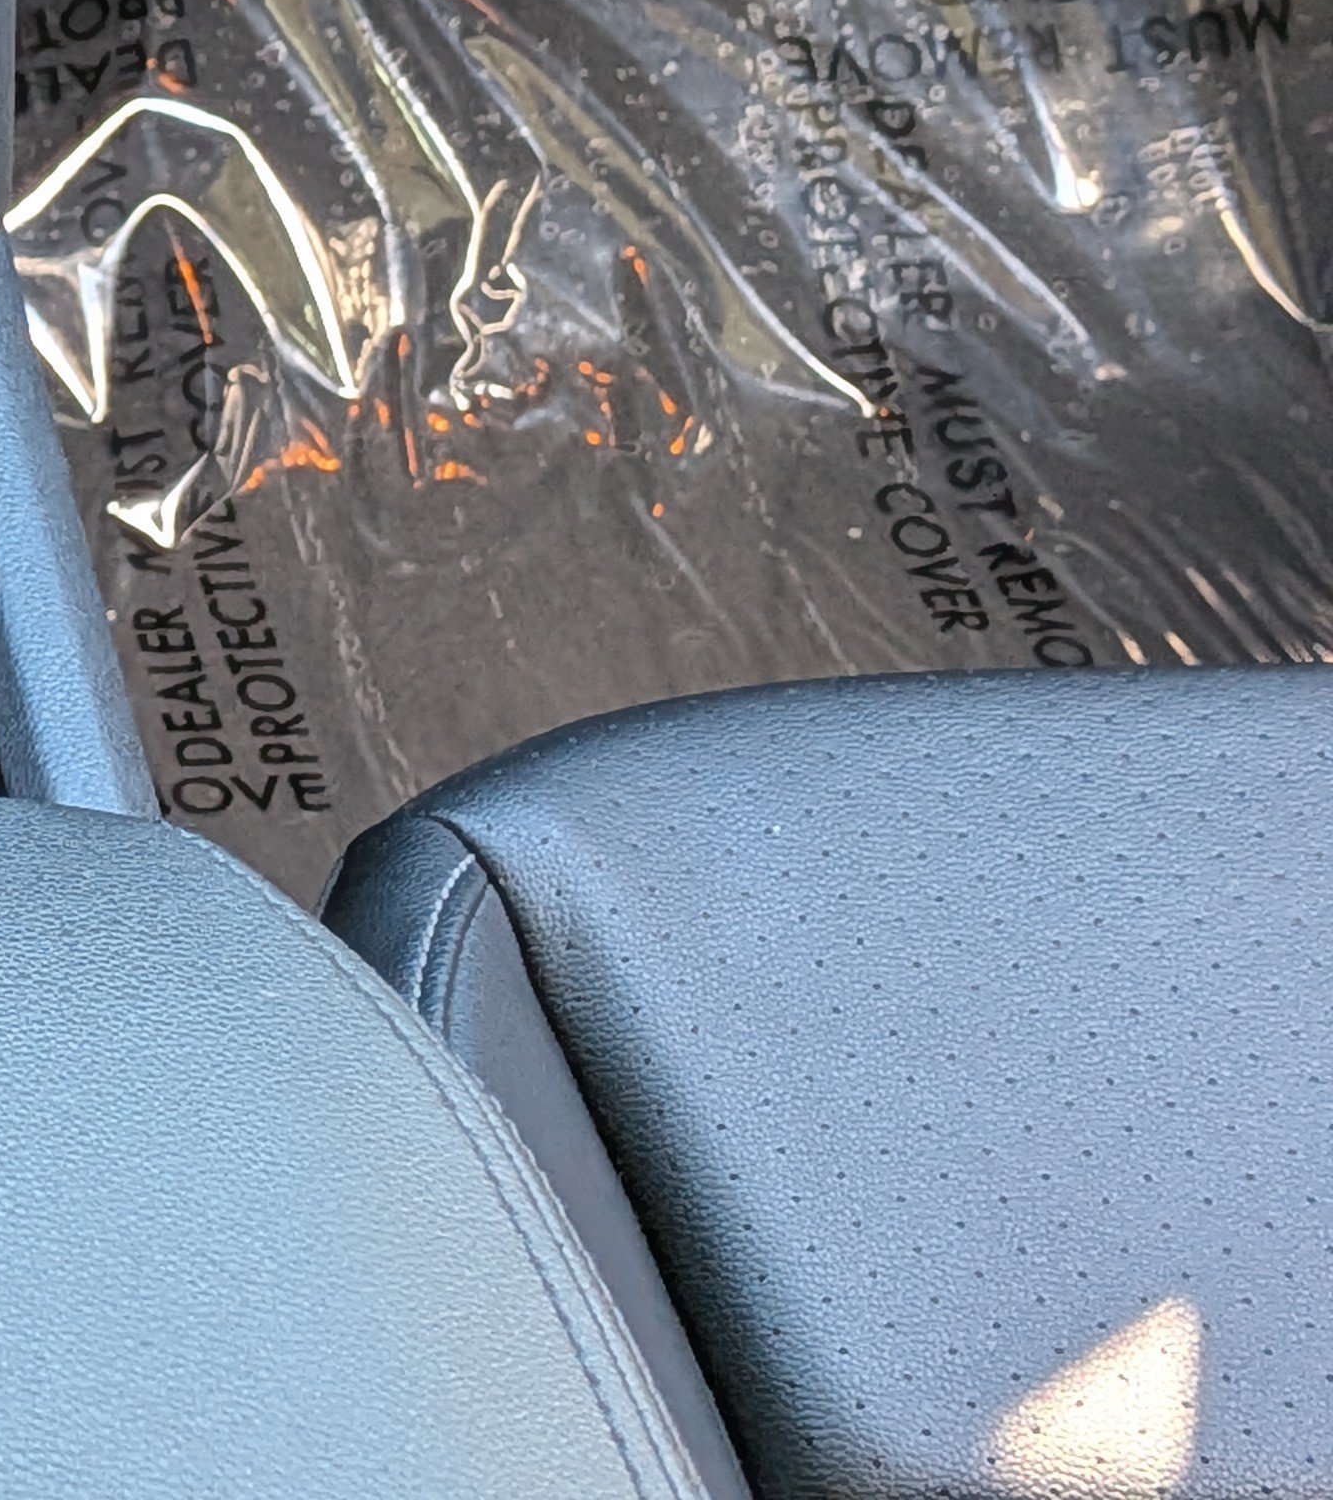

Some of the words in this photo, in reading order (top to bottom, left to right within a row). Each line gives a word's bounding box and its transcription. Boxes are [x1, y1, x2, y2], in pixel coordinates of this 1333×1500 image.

[875, 482, 990, 635] COVER
[915, 363, 1017, 519] MUST
[979, 540, 1097, 669] REMO
[134, 605, 234, 768] DEALER
